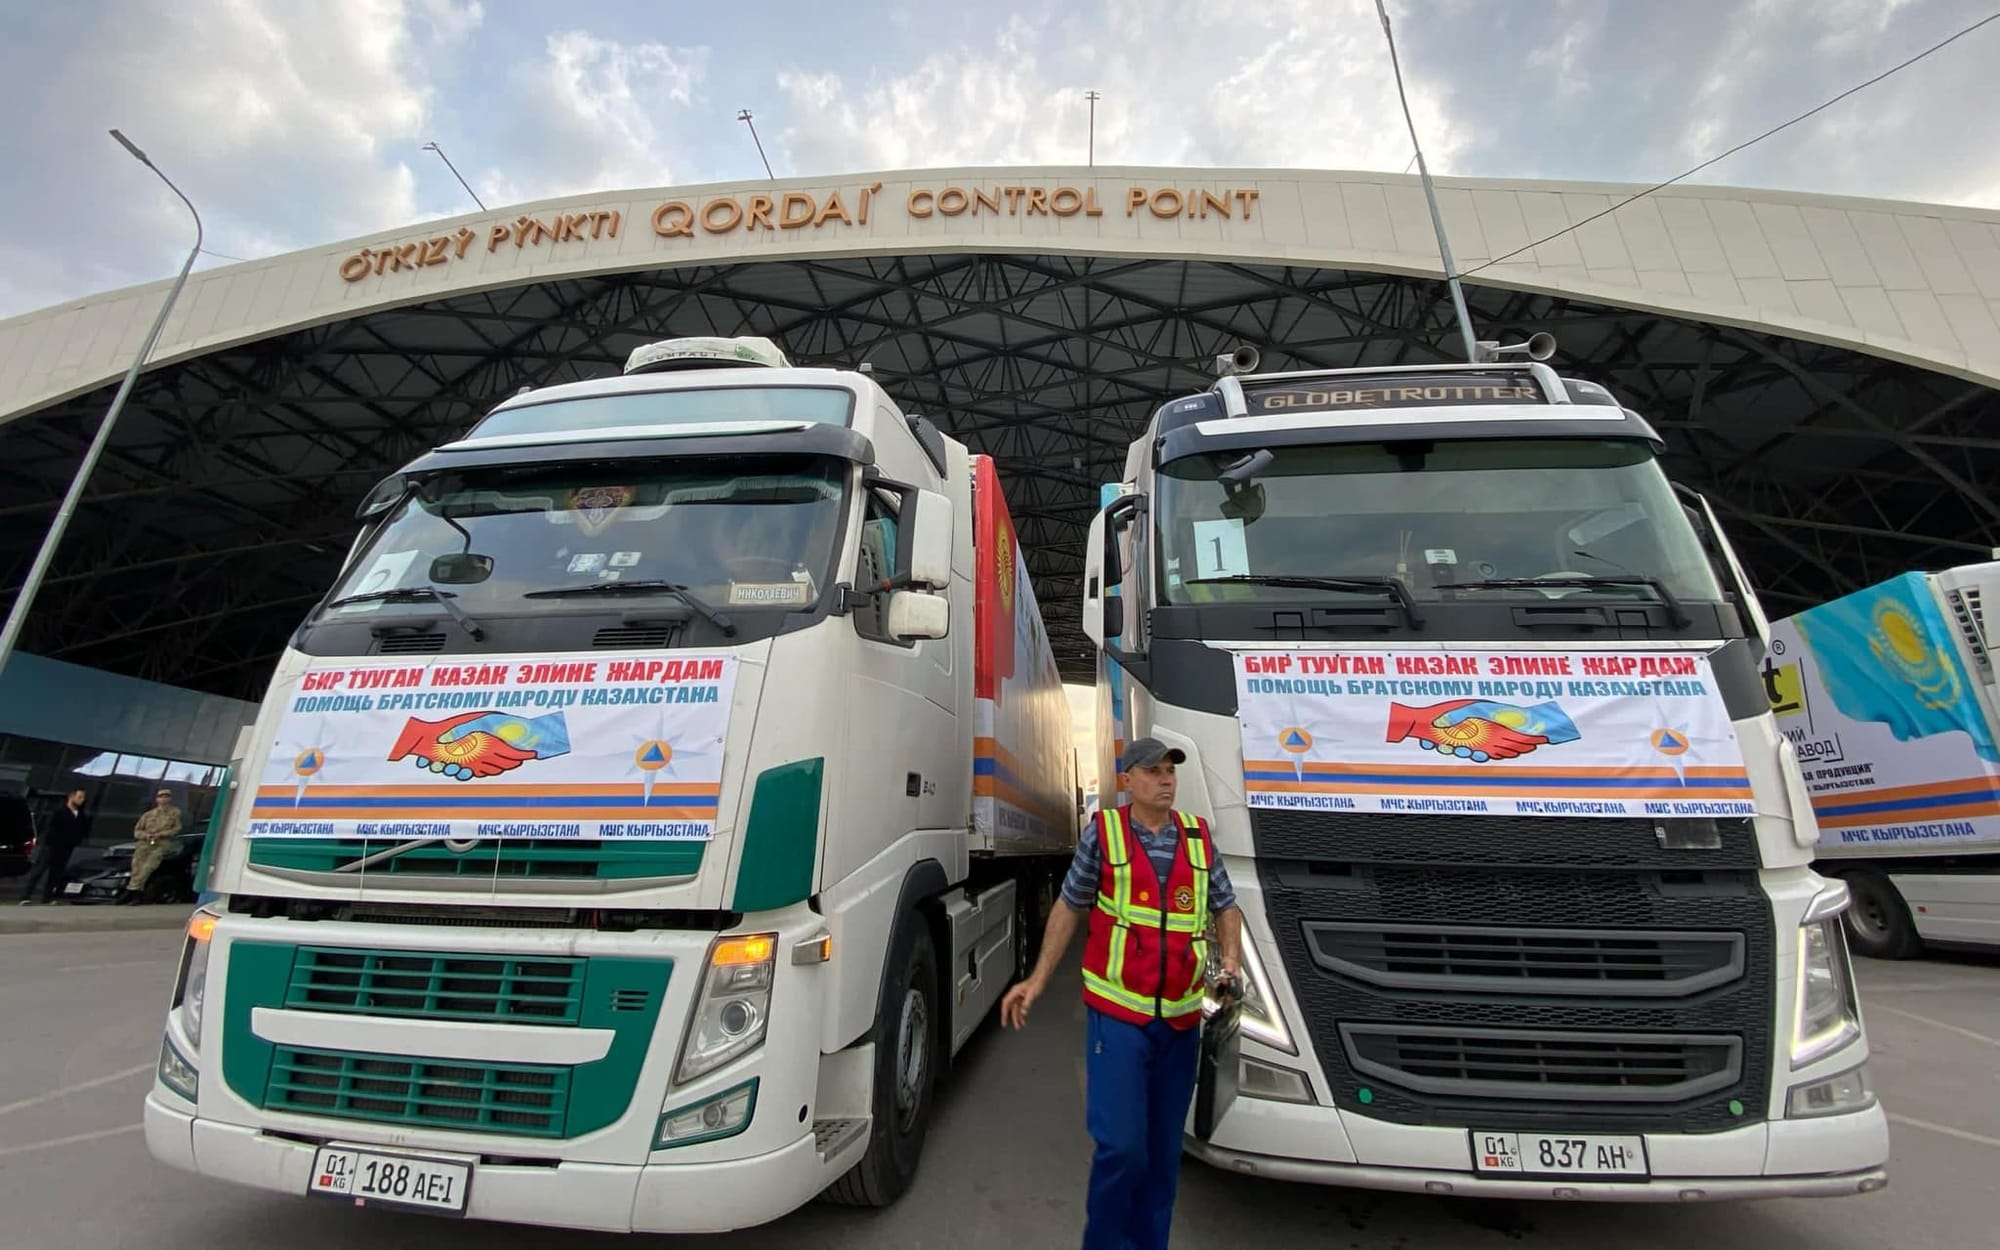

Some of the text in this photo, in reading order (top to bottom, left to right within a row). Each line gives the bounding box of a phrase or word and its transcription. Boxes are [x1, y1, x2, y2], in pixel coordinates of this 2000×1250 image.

[906, 185, 1104, 219] CONTROL
[1126, 187, 1260, 220] POINT
[1264, 386, 1538, 409] GLOBETROTTER
[1208, 536, 1228, 573] 1
[301, 659, 724, 691] БИР ТУУГАН КАЗАК ЭЛИНЕ ЖАРДАМ
[1245, 656, 1697, 678] БИР ТУУГАН КАЗАК ЭЛИНЕ ЖАРДАМ
[1246, 678, 1708, 699] ПОМОЩЬ БРАТСКОМУ НАРОДУ КАЗАХСТАНА
[292, 685, 719, 714] ПОМОЩЬ БРАТСКОМУ НАРОДУ КАЗАХСТАНА
[1250, 795, 1354, 808] МЧС КЫРГЫЗСТАНА
[1380, 798, 1488, 812] МЧС КЫРГЫЗСТАНА
[1516, 801, 1627, 814] МЧС КЫРГЫЗСТАНА
[1645, 802, 1754, 814] МЧС КЫРГЫЗСТАНА
[269, 822, 335, 834] КЫРГЫЗСТАНА
[356, 823, 451, 836] МЧС КЫРГЫЗСТАНА
[477, 823, 580, 837] МЧС КЫРГЫЗСТАНА
[599, 823, 710, 837] МЧС КЫРГЫЗСТАНА
[1840, 821, 1976, 843] МЧС КЫРГЫЗСТАНА
[1484, 1136, 1509, 1156] 01
[1538, 1139, 1627, 1169] 837 AH
[325, 1154, 347, 1176] 01
[1500, 1156, 1515, 1168] KG
[332, 1176, 347, 1189] KG
[361, 1160, 411, 1196] 188
